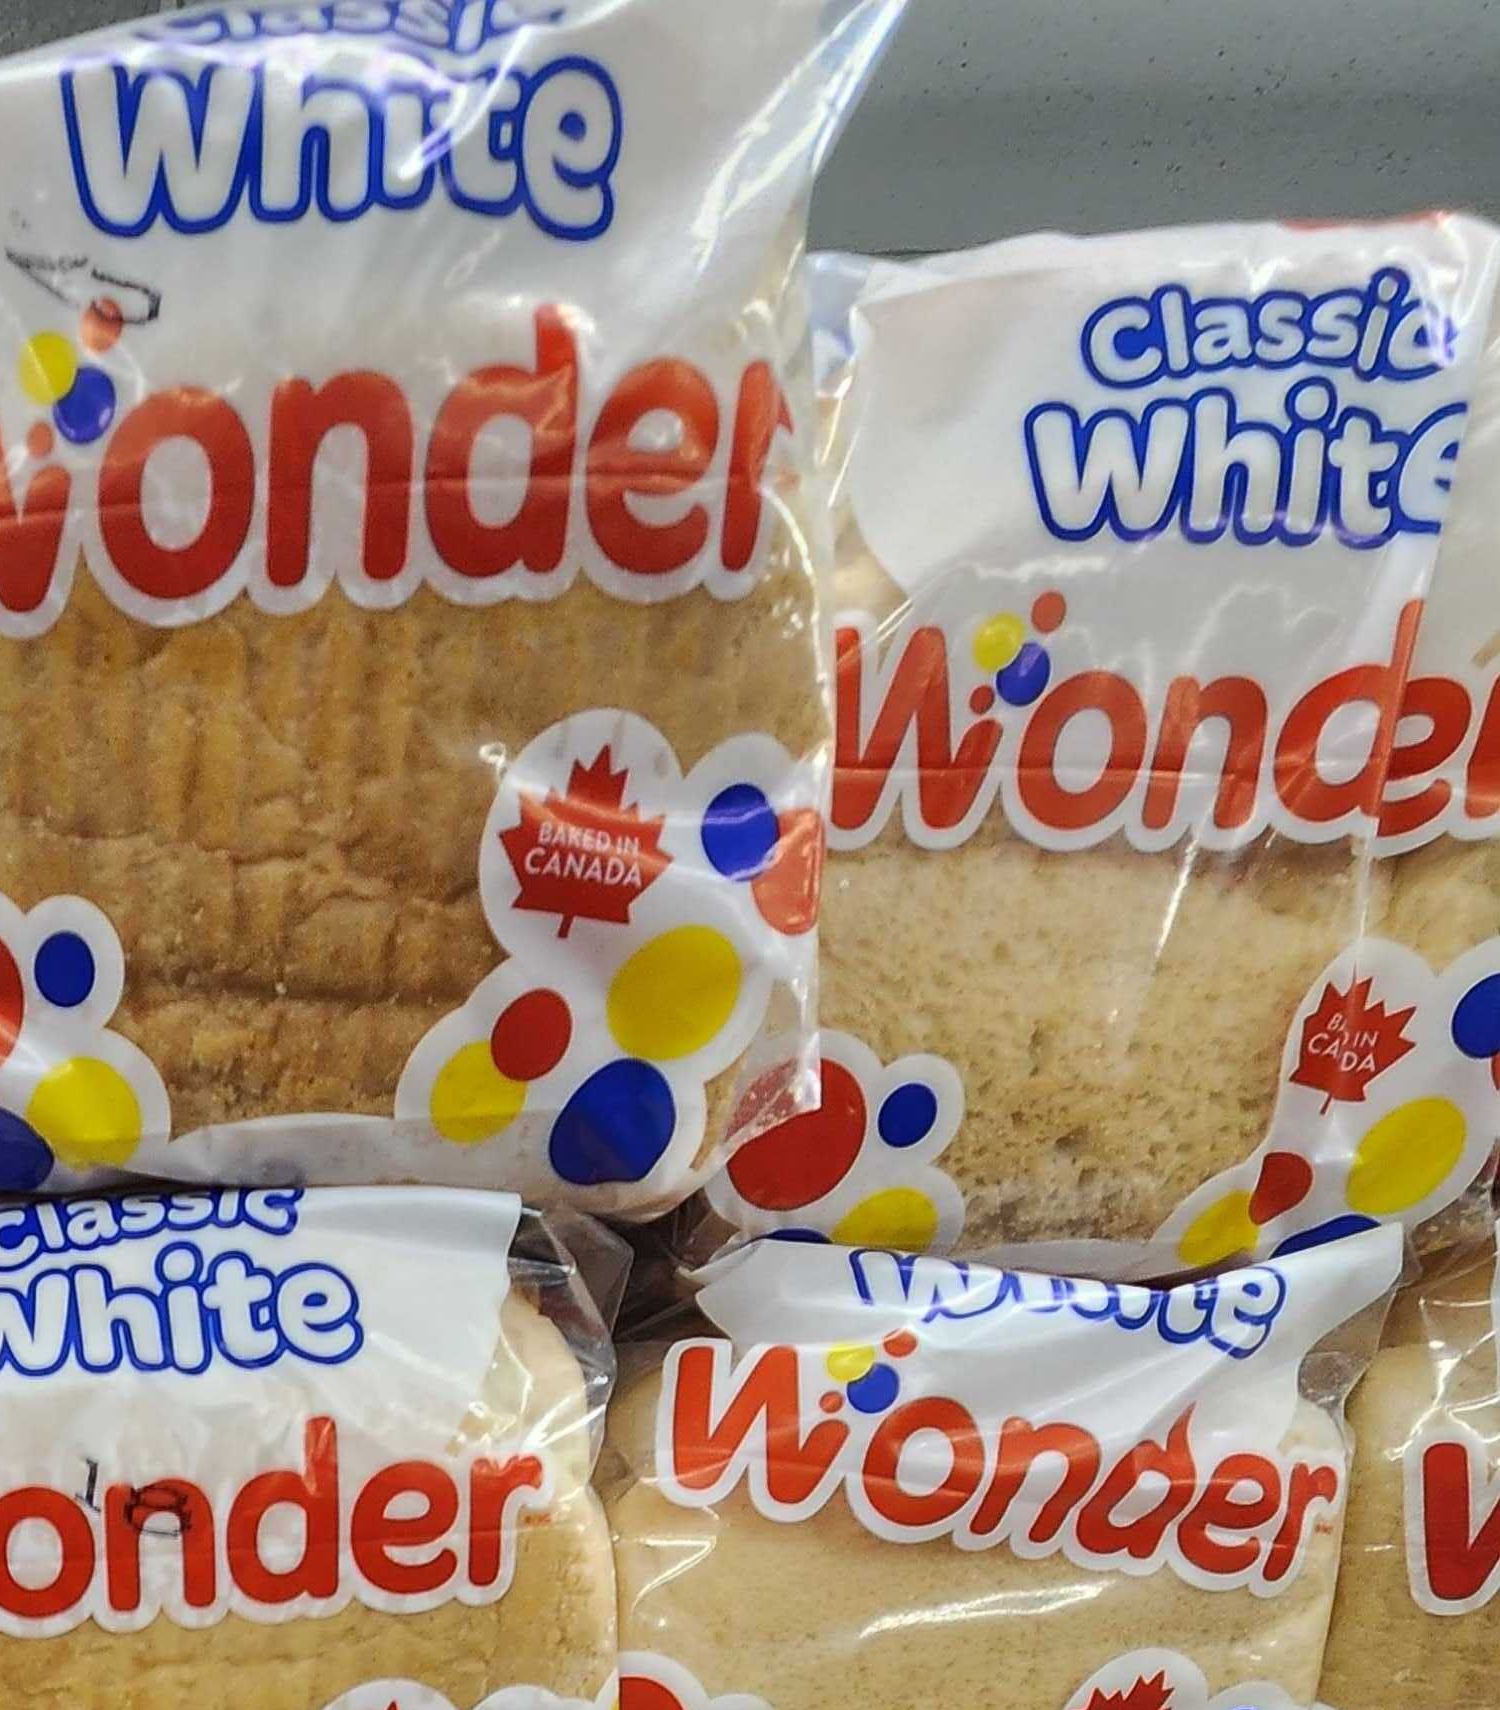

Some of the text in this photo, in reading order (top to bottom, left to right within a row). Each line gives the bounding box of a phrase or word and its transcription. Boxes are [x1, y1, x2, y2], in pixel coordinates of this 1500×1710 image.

[1081, 266, 1457, 389] Classic
[539, 822, 640, 858] BAKED IN
[523, 846, 642, 888] CANADA
[1353, 1031, 1379, 1047] IN
[672, 1344, 1337, 1581] Wonder
